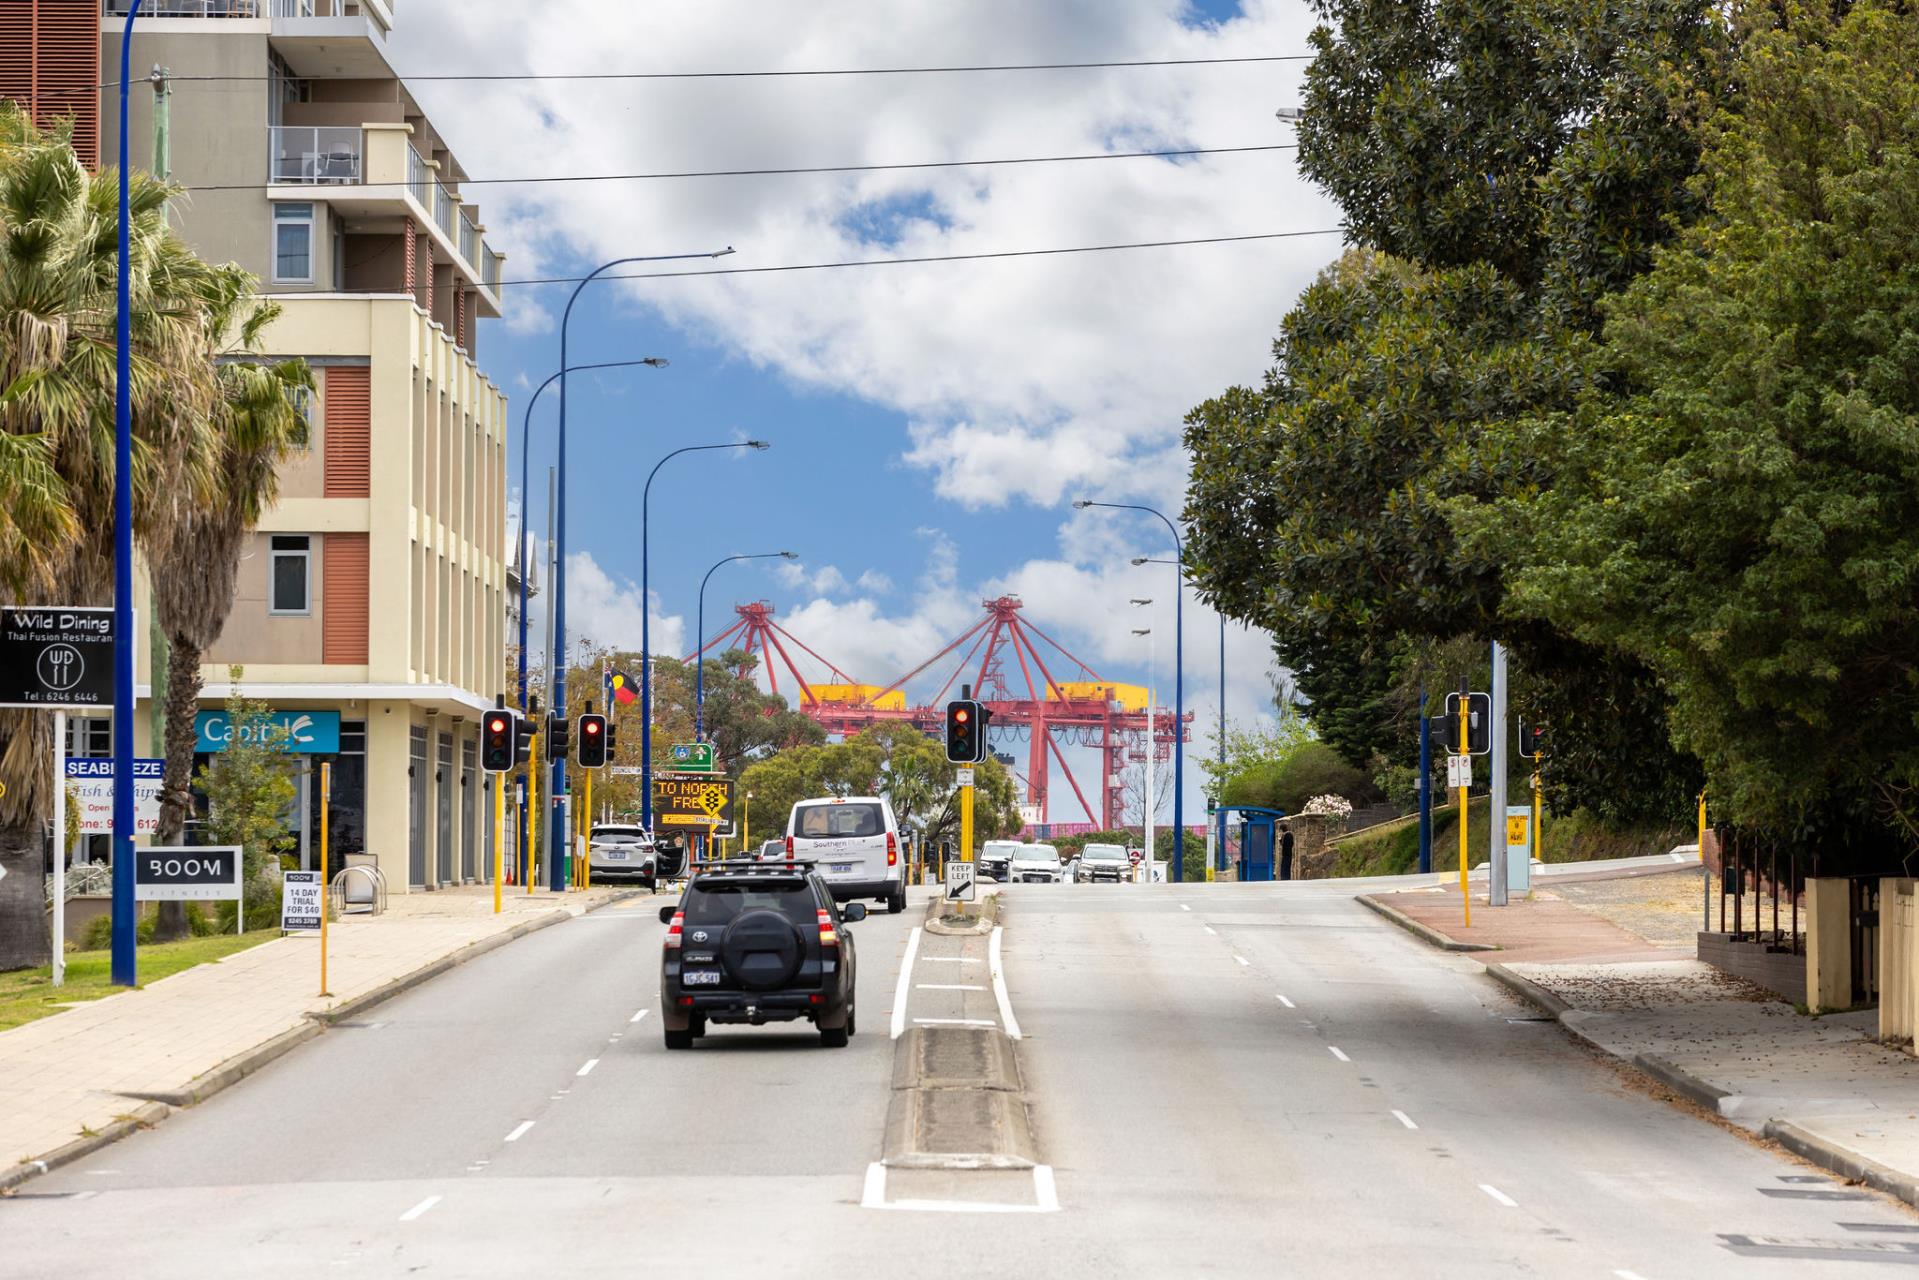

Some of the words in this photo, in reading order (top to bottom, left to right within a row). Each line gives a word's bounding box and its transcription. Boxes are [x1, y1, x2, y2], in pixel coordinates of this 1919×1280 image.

[14, 614, 53, 629] Wild
[59, 614, 110, 633] Dining
[7, 631, 27, 641] Thai
[29, 631, 60, 641] Fusion
[62, 632, 114, 642] Restauran
[46, 692, 70, 701] 6246
[74, 692, 98, 702] 6446
[68, 762, 161, 775] SEABEZE
[658, 782, 677, 794] TO
[681, 783, 728, 795] NORH
[88, 804, 110, 812] Open
[80, 820, 103, 829] one:
[813, 840, 847, 849] Southern
[150, 859, 221, 876] BOOM
[951, 872, 970, 880] LEFT
[290, 889, 300, 897] 14
[302, 889, 318, 897] DAY
[292, 897, 315, 905] TRIAL
[287, 906, 303, 914] FOR
